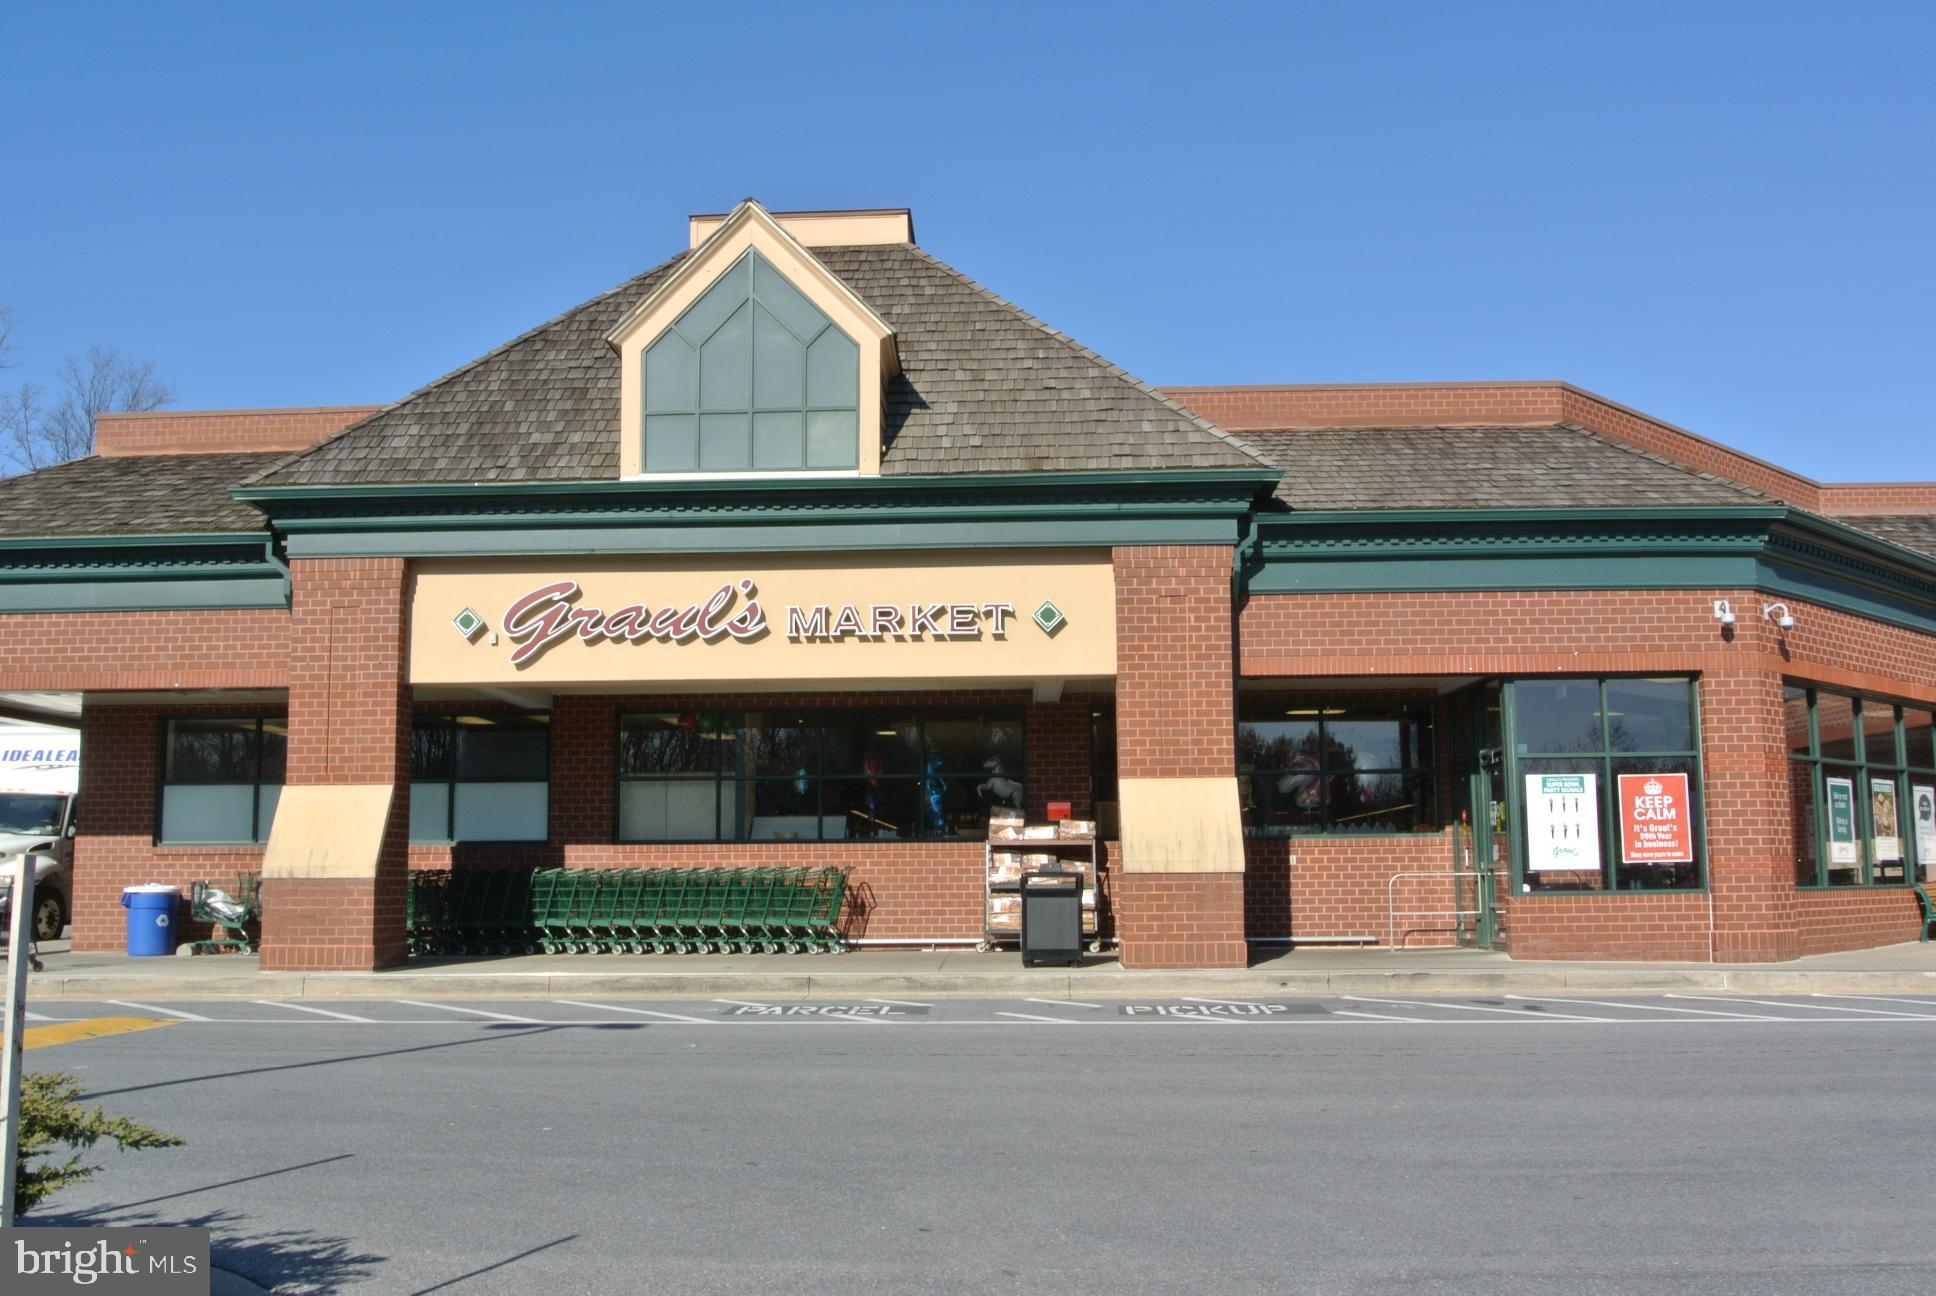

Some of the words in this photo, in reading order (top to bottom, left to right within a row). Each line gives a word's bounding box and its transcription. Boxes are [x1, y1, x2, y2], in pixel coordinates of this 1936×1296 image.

[501, 579, 767, 666] Graul's
[786, 602, 1013, 641] MARKET
[2, 749, 81, 762] IDEALEA
[1634, 795, 1673, 808] KEEP
[1633, 807, 1676, 820] CALM
[733, 1005, 906, 1016] PARCEL
[1125, 1004, 1288, 1016] PICKUP
